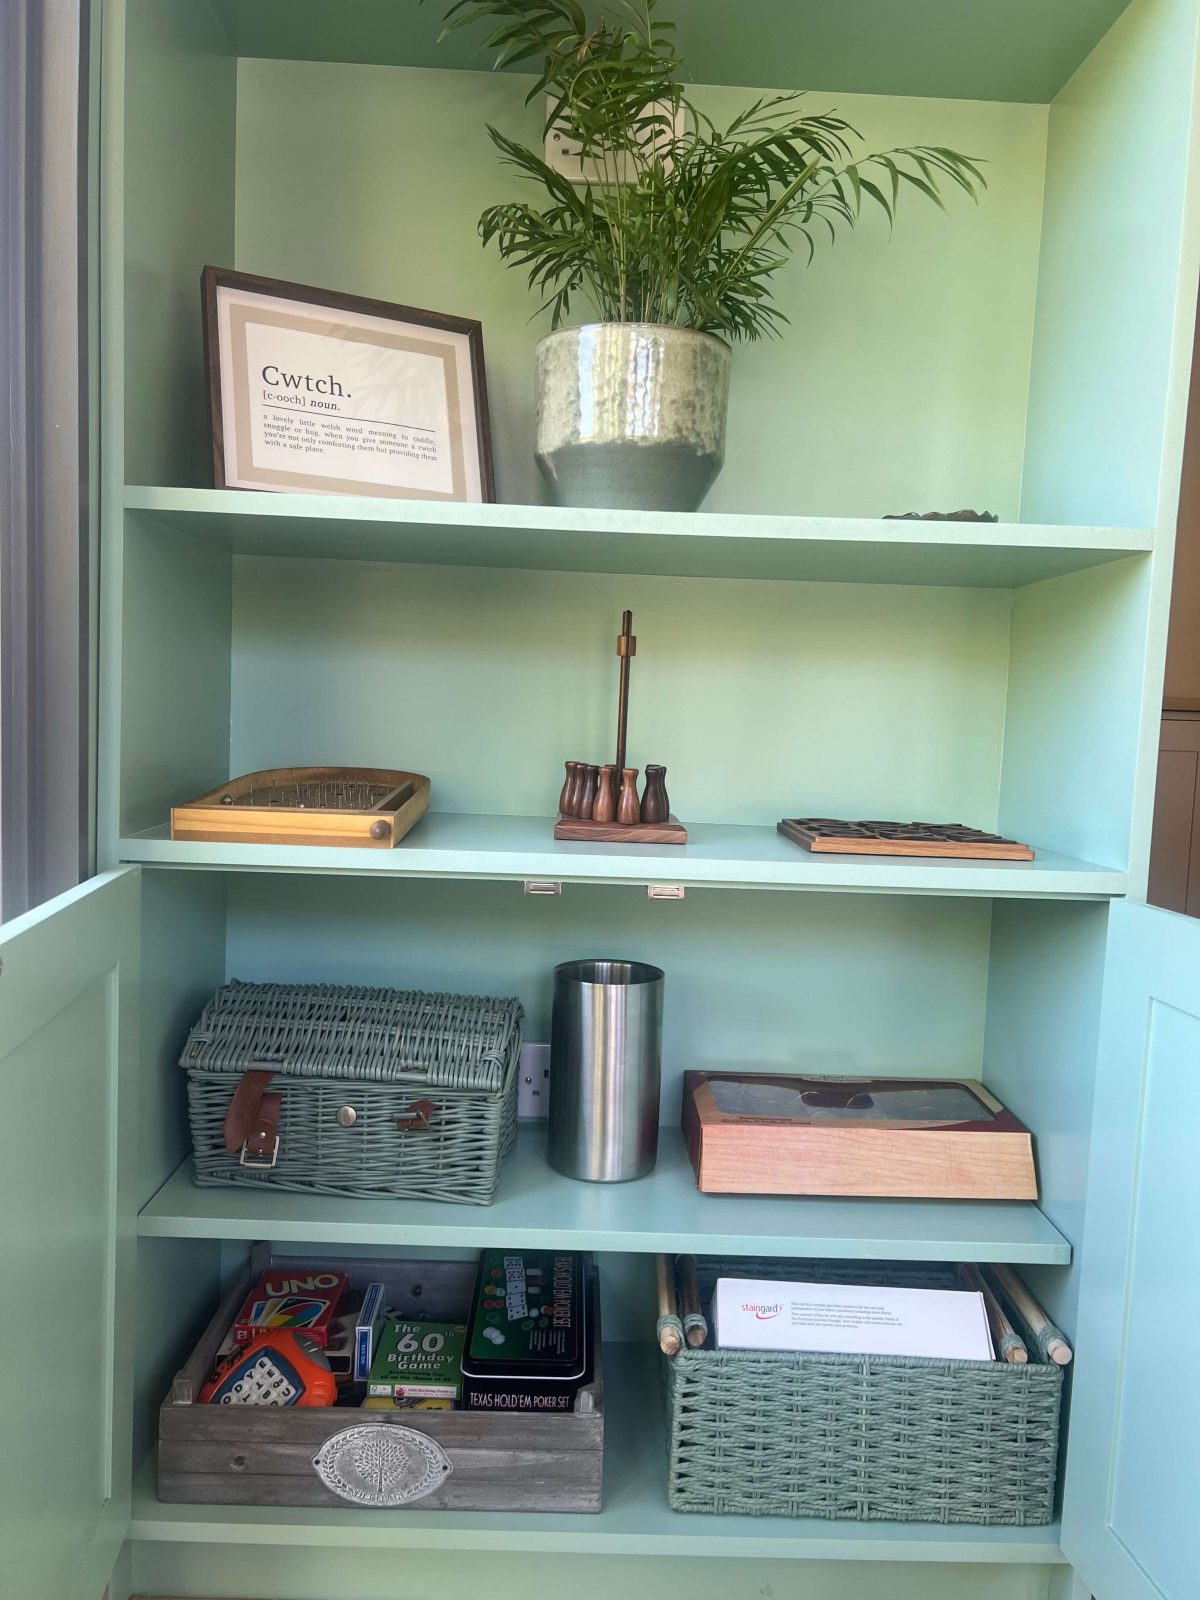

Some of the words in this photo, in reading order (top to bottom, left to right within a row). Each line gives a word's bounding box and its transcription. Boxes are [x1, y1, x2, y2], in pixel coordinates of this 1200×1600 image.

[262, 366, 352, 398] Cwtch.
[263, 390, 306, 407] [c-ooch]
[310, 399, 341, 411] noun.
[273, 414, 294, 424] lovely
[300, 419, 316, 427] little
[368, 430, 396, 439] meaning
[264, 423, 291, 432] snuggle
[379, 439, 408, 448] someone
[318, 438, 355, 450] comforting
[389, 449, 420, 459] providing
[554, 1256, 573, 1272] TEXAS
[265, 1274, 339, 1296] UNO
[741, 1303, 779, 1315] staingard
[394, 1324, 421, 1333] The
[553, 1318, 571, 1327] SET
[387, 1353, 454, 1363] Birthday
[397, 1361, 441, 1370] Game
[246, 1371, 254, 1380] Y
[267, 1369, 275, 1378] E
[282, 1388, 290, 1396] U
[234, 1384, 242, 1393] D
[223, 1396, 231, 1404] O
[470, 1392, 493, 1406] TEXAS
[494, 1394, 532, 1408] HOLD'EM
[534, 1396, 556, 1407] POKER
[558, 1396, 569, 1408] SET
